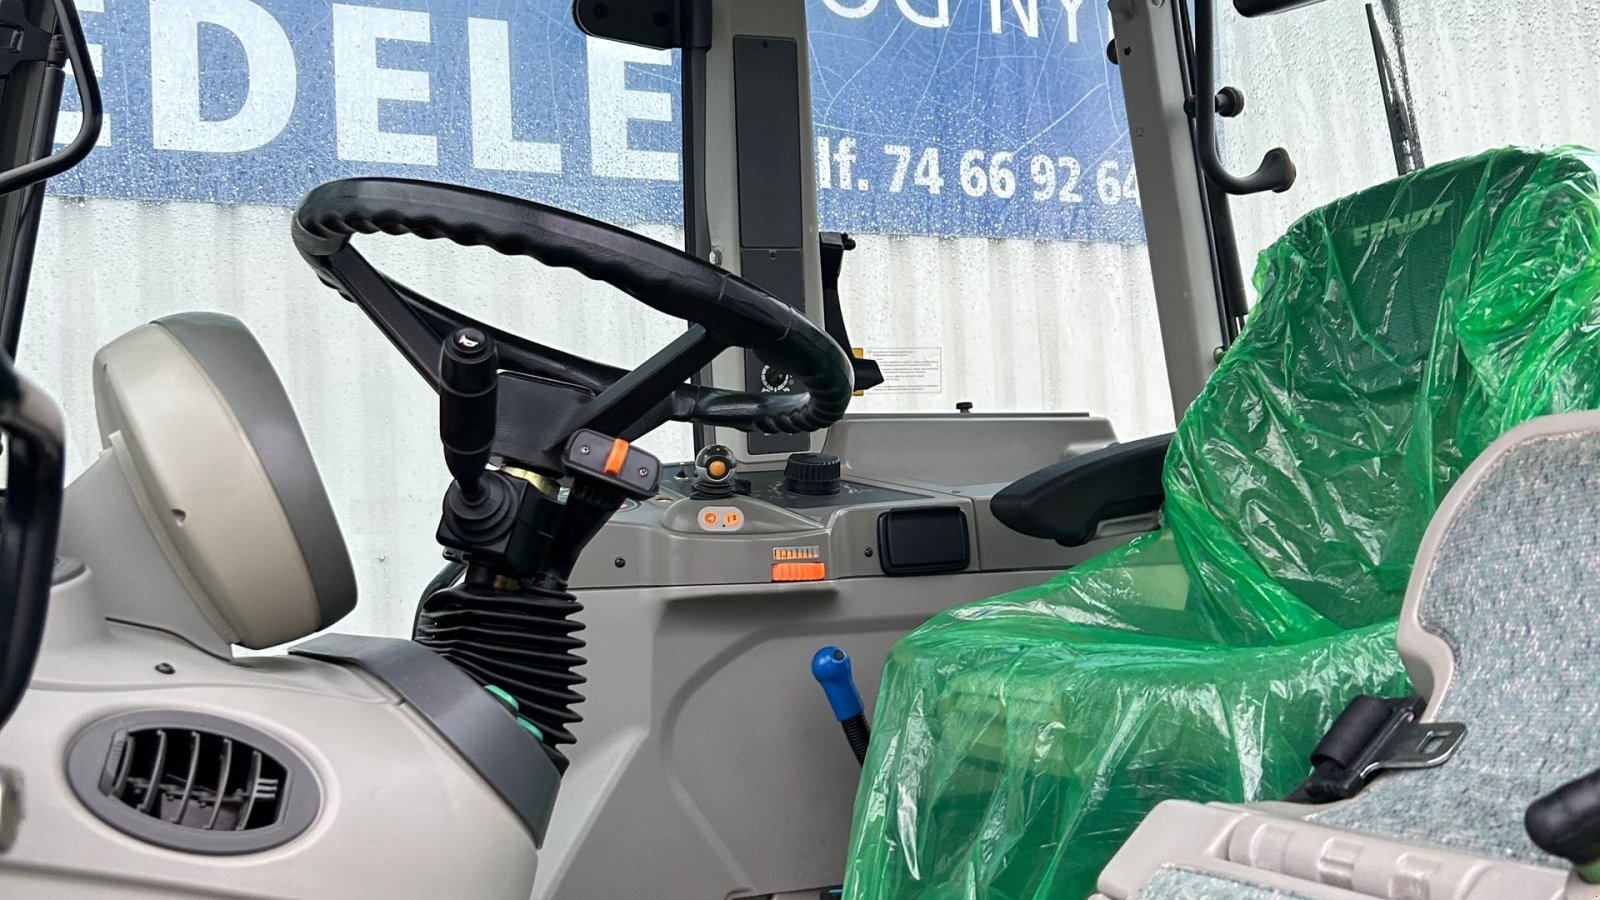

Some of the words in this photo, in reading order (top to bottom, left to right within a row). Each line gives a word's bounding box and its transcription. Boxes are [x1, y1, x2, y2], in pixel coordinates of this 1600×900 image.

[883, 143, 945, 196] 74
[959, 149, 1017, 200] 66
[1030, 153, 1084, 204] 92
[1096, 159, 1142, 208] 64
[1353, 199, 1455, 247] FENDT
